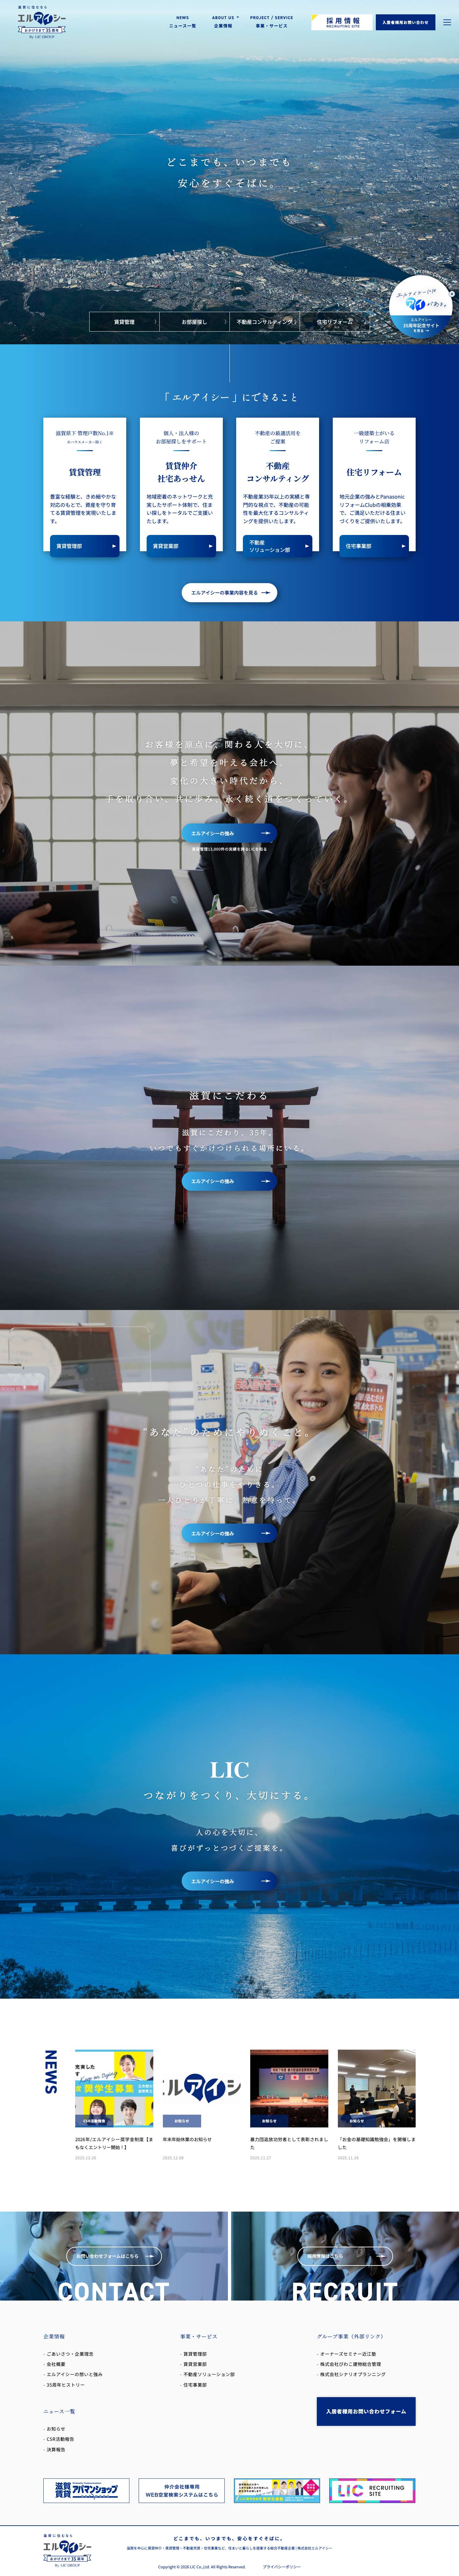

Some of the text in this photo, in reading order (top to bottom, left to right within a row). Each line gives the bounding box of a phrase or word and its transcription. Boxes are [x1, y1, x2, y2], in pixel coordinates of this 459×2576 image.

[18, 12, 66, 25] エルアイシー
[45, 2051, 57, 2094] NEWS
[84, 2084, 134, 2093] 奨学生募集
[163, 2073, 241, 2104] ルアイシ
[72, 2485, 118, 2493] アパマンショップ
[338, 2485, 364, 2497] LIC
